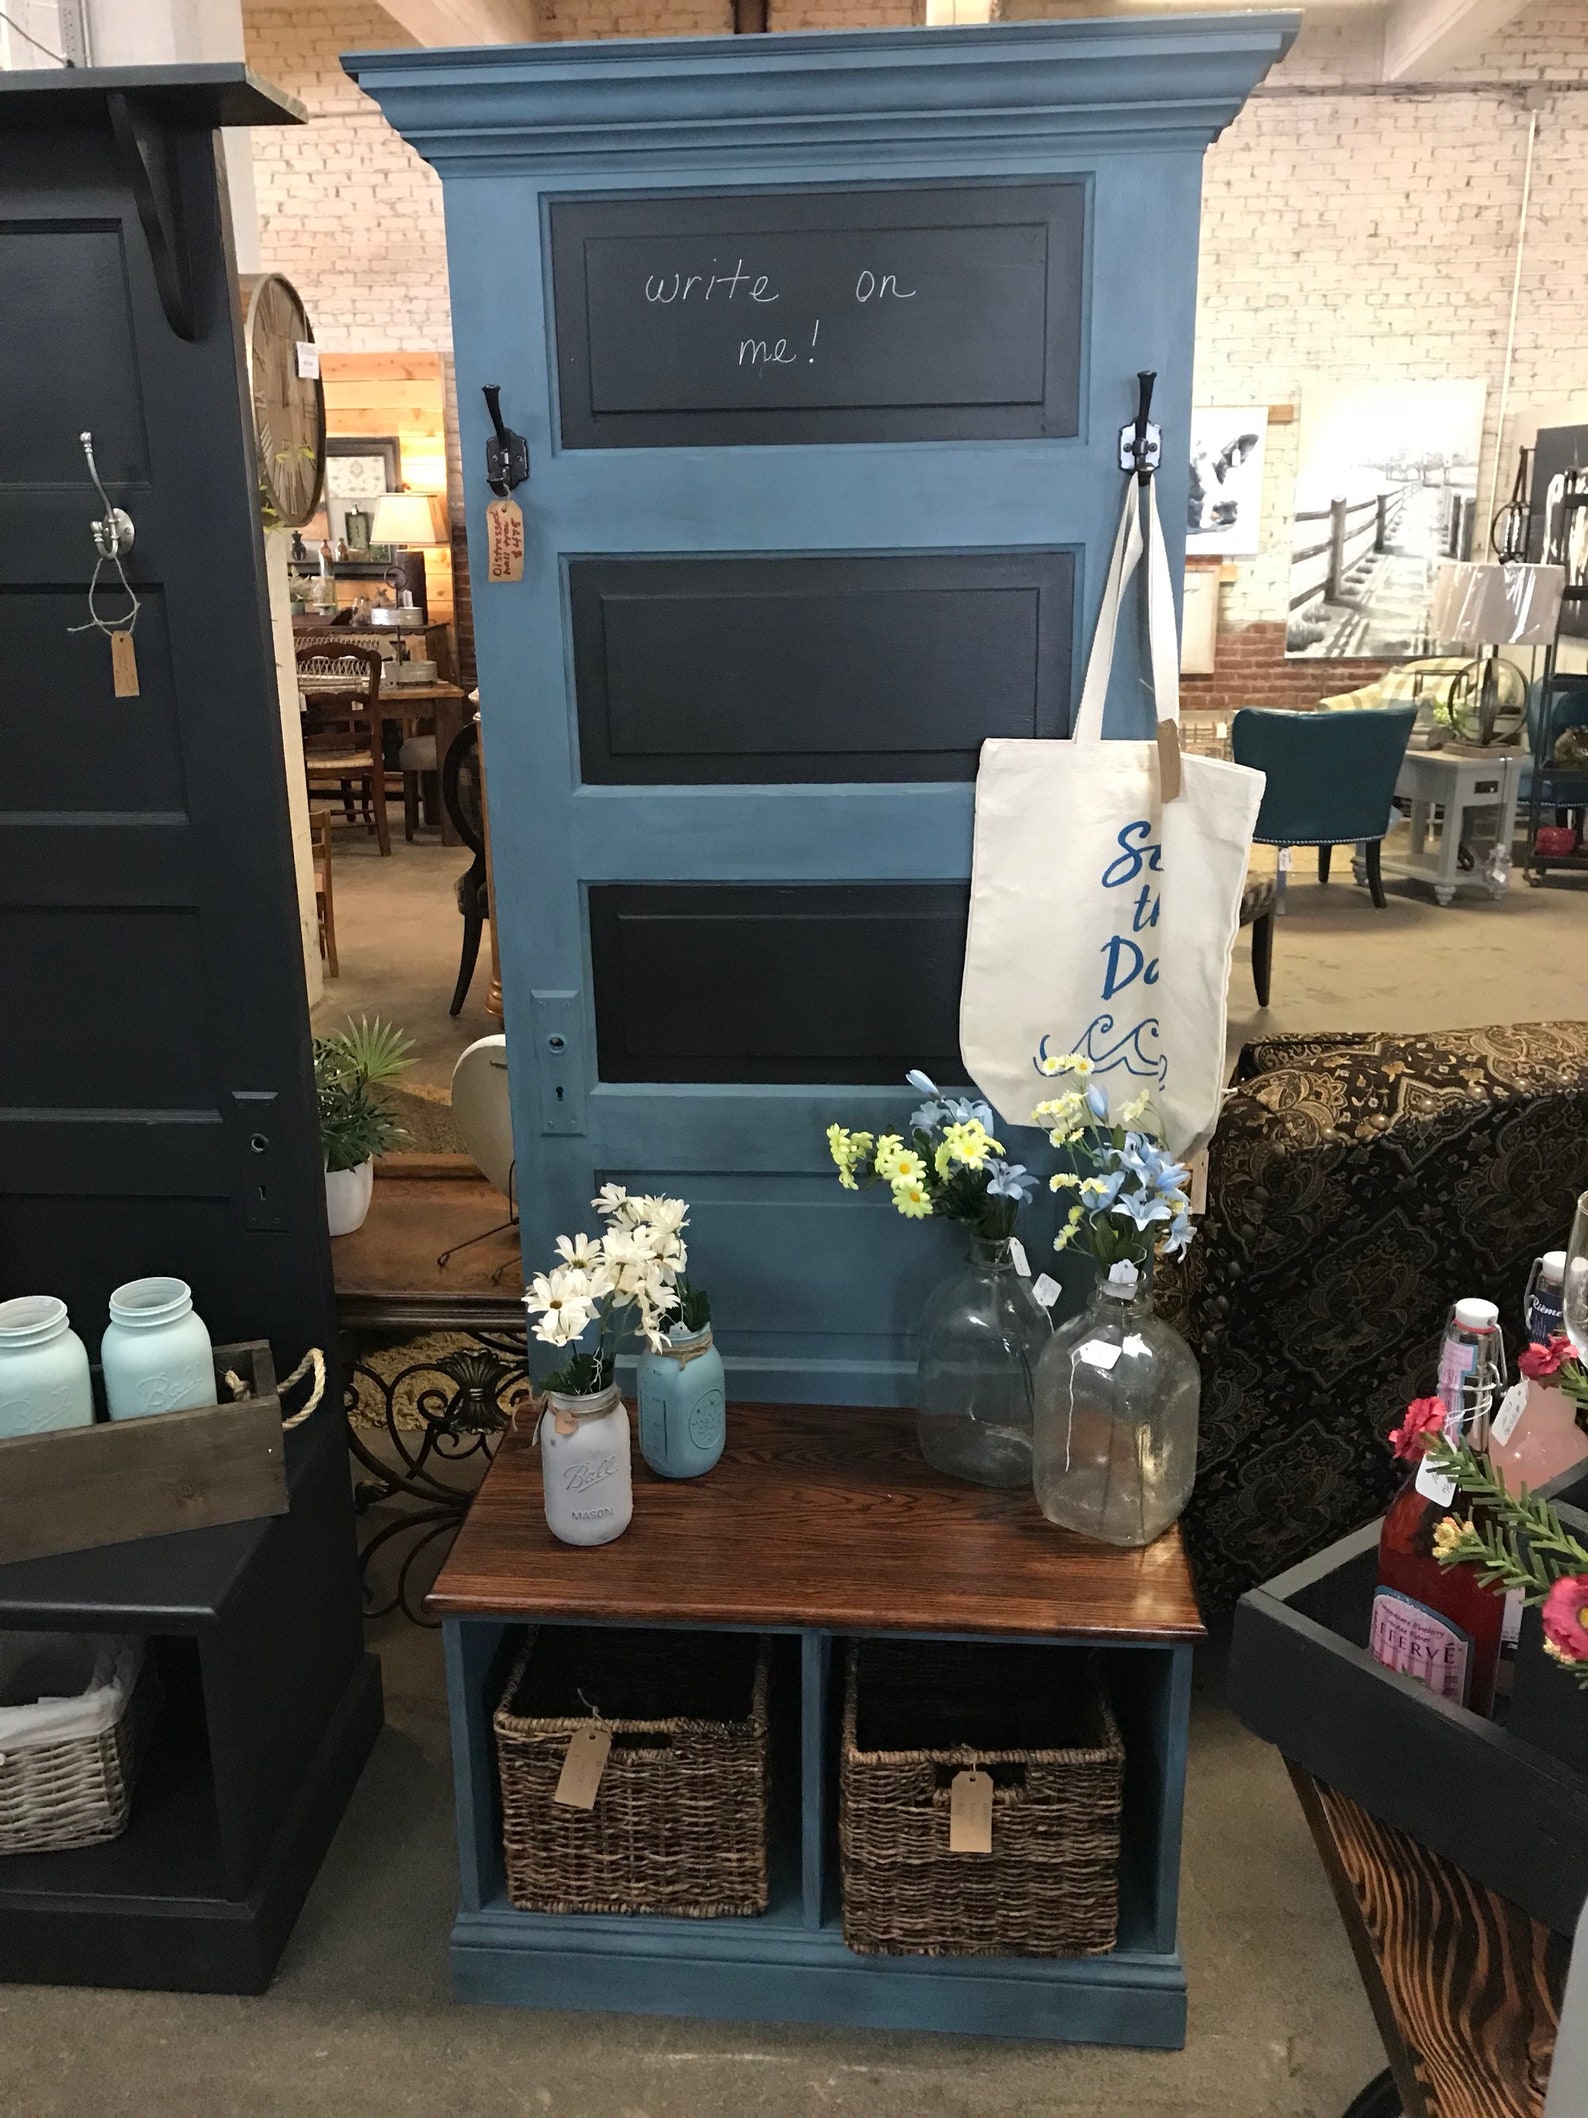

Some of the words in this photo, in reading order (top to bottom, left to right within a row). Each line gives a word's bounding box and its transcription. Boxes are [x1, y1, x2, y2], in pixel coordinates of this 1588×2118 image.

[645, 259, 779, 303] write
[856, 270, 916, 302] on
[738, 319, 819, 365] me!
[490, 511, 502, 576] Distressed
[563, 1455, 618, 1493] Ball
[571, 1507, 614, 1521] MASON
